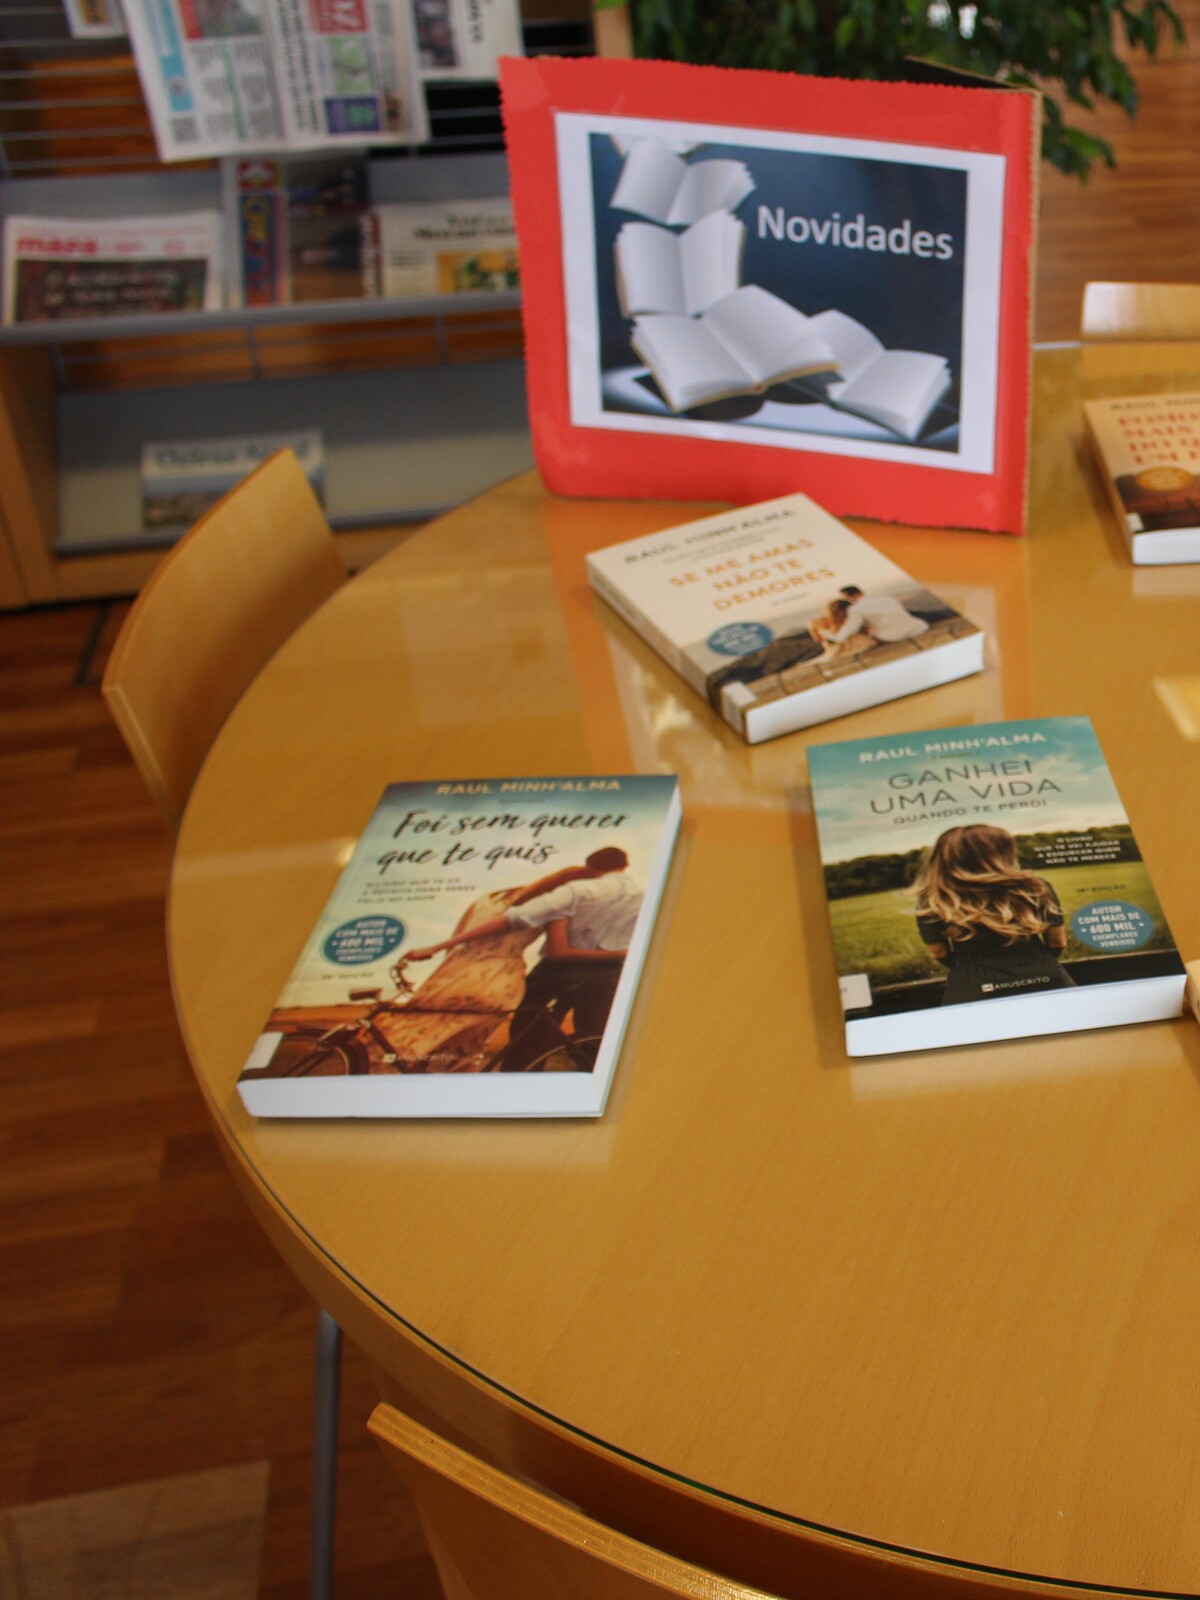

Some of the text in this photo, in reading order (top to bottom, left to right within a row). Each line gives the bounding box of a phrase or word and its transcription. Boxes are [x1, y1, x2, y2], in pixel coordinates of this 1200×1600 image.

[758, 205, 954, 260] Novidades
[668, 571, 699, 588] SE
[704, 558, 743, 577] ME
[748, 538, 815, 563] AMAS
[712, 557, 804, 592] NÃO TE
[712, 566, 836, 611] DEMORES
[858, 747, 920, 763] RAUL
[923, 732, 1047, 756] MINH'ALMA
[436, 780, 622, 796] RAUL MINH'ALMA
[888, 759, 1033, 791] GANHEI
[870, 778, 1063, 815] UMA VIDA
[392, 808, 631, 839] Foi sem querer
[893, 799, 1048, 825] QUANDO TE PERDI
[1046, 849, 1094, 858] ESQUECER
[1080, 853, 1117, 862] MERECE
[1084, 840, 1120, 848] AJUDAR
[376, 842, 557, 876] que te quis
[1078, 912, 1142, 926] COM MAIS DE
[1091, 905, 1122, 915] AUTOR
[1090, 920, 1136, 934] 600 MIL
[1092, 931, 1139, 941] EXEMPLARES
